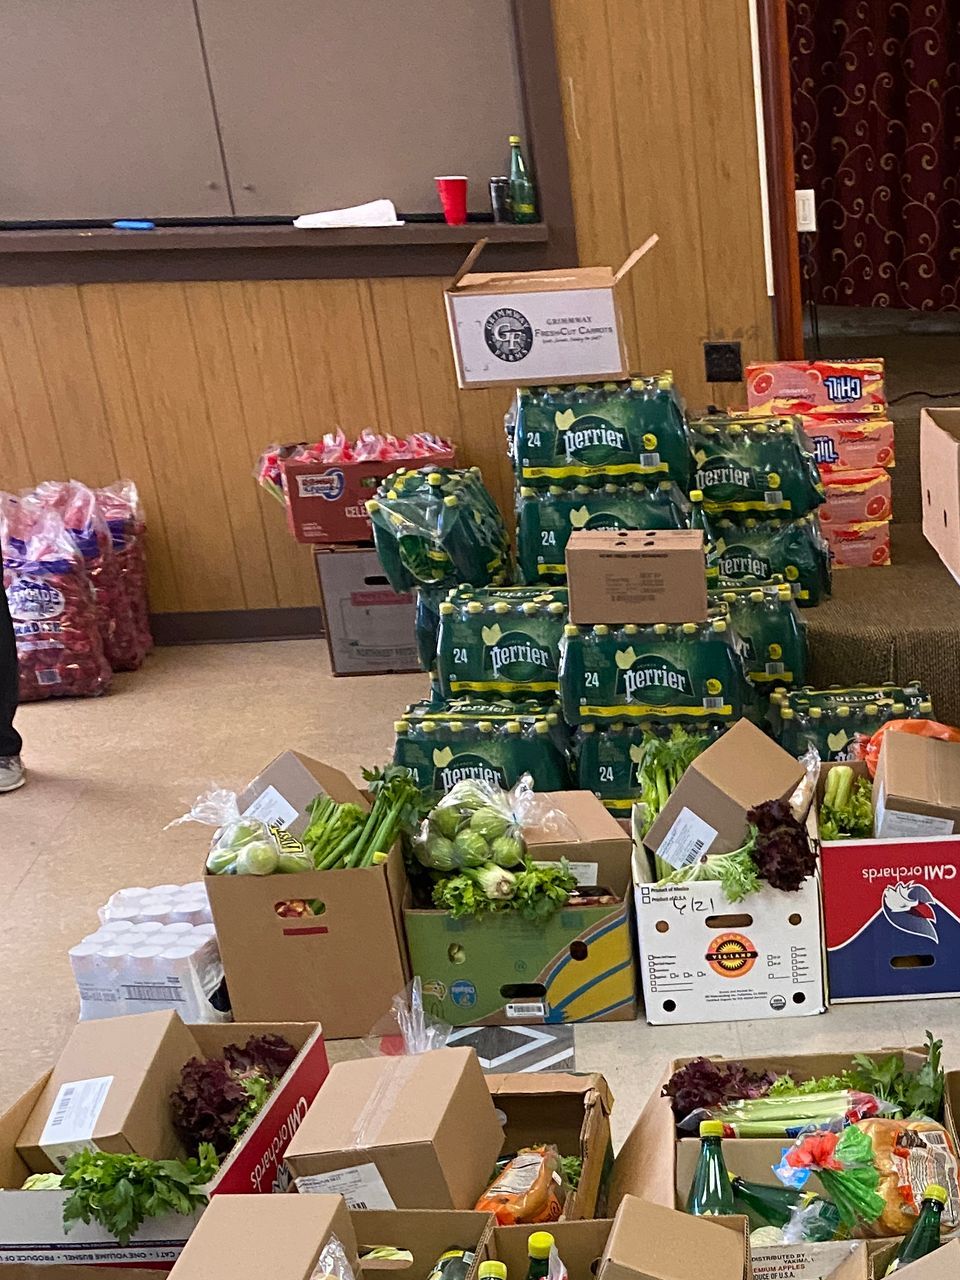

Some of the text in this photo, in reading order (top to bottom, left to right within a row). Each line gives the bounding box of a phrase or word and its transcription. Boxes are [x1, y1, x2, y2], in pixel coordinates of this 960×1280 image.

[526, 432, 542, 448] 24
[563, 425, 625, 462] perrier
[541, 530, 556, 546] 24
[452, 647, 468, 664] 24
[489, 642, 549, 679] perrier
[583, 671, 600, 688] 24
[622, 664, 687, 702] perrier
[599, 766, 614, 782] 24
[861, 864, 957, 884] CMI orchards
[250, 1096, 308, 1193] CMI orchards
[751, 1254, 795, 1262] DISTRIBUTED
